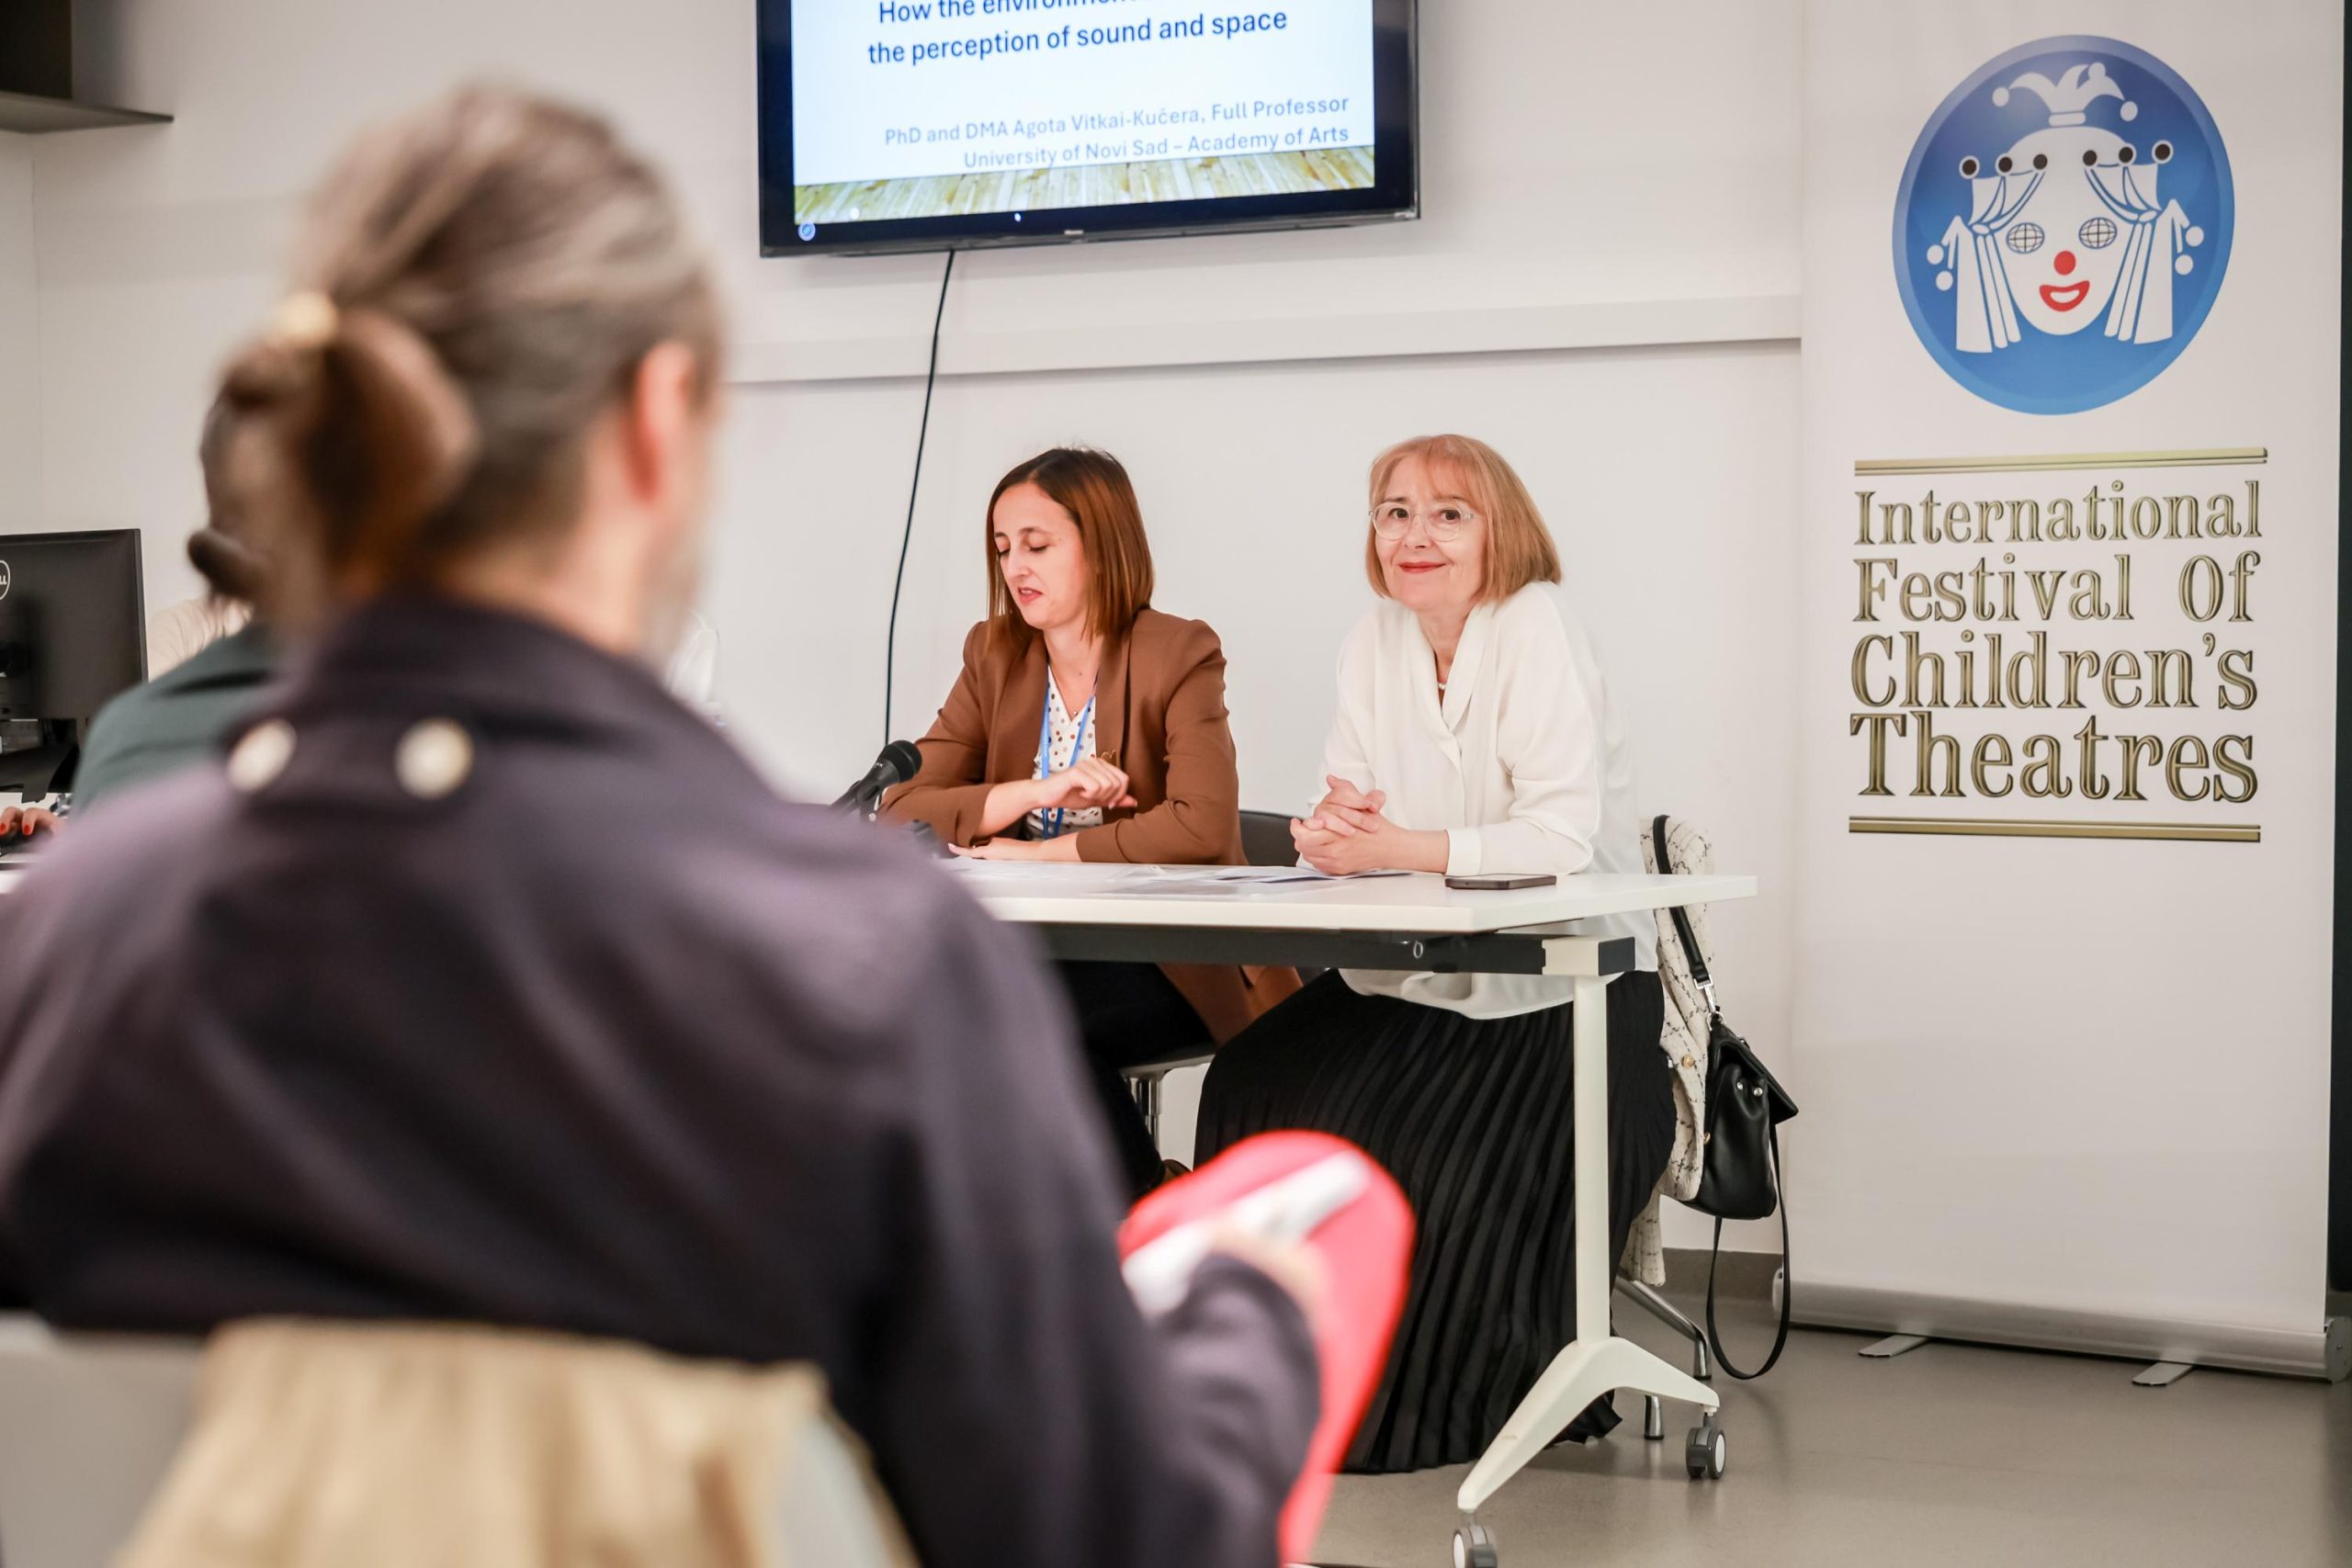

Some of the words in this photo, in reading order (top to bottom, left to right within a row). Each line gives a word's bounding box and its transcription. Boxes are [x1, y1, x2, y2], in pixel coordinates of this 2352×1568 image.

[868, 42, 905, 63] the
[912, 30, 1039, 66] perception
[1046, 26, 1070, 49] of
[1077, 17, 1151, 46] sound
[1159, 13, 1204, 39] and
[1212, 11, 1288, 39] space
[879, 1, 931, 23] How
[938, 0, 975, 17] the
[885, 127, 922, 145] PhD
[926, 125, 960, 141] and
[966, 120, 1008, 140] DMA
[1013, 118, 1066, 139] Agota
[1212, 101, 1247, 121] Full
[1254, 97, 1350, 118] Professor
[965, 146, 1057, 169] University
[1062, 144, 1081, 162] of
[1086, 141, 1127, 159] Novi
[1133, 138, 1168, 156] Sad
[1188, 132, 1279, 153] Academy
[1284, 128, 1304, 145] of
[1308, 126, 1349, 143] Arts
[1854, 480, 2263, 545] International
[1853, 552, 2134, 622] Festival
[2178, 550, 2261, 623] Of
[1850, 630, 2258, 711] Children’s
[1849, 711, 2258, 803] Theatres
